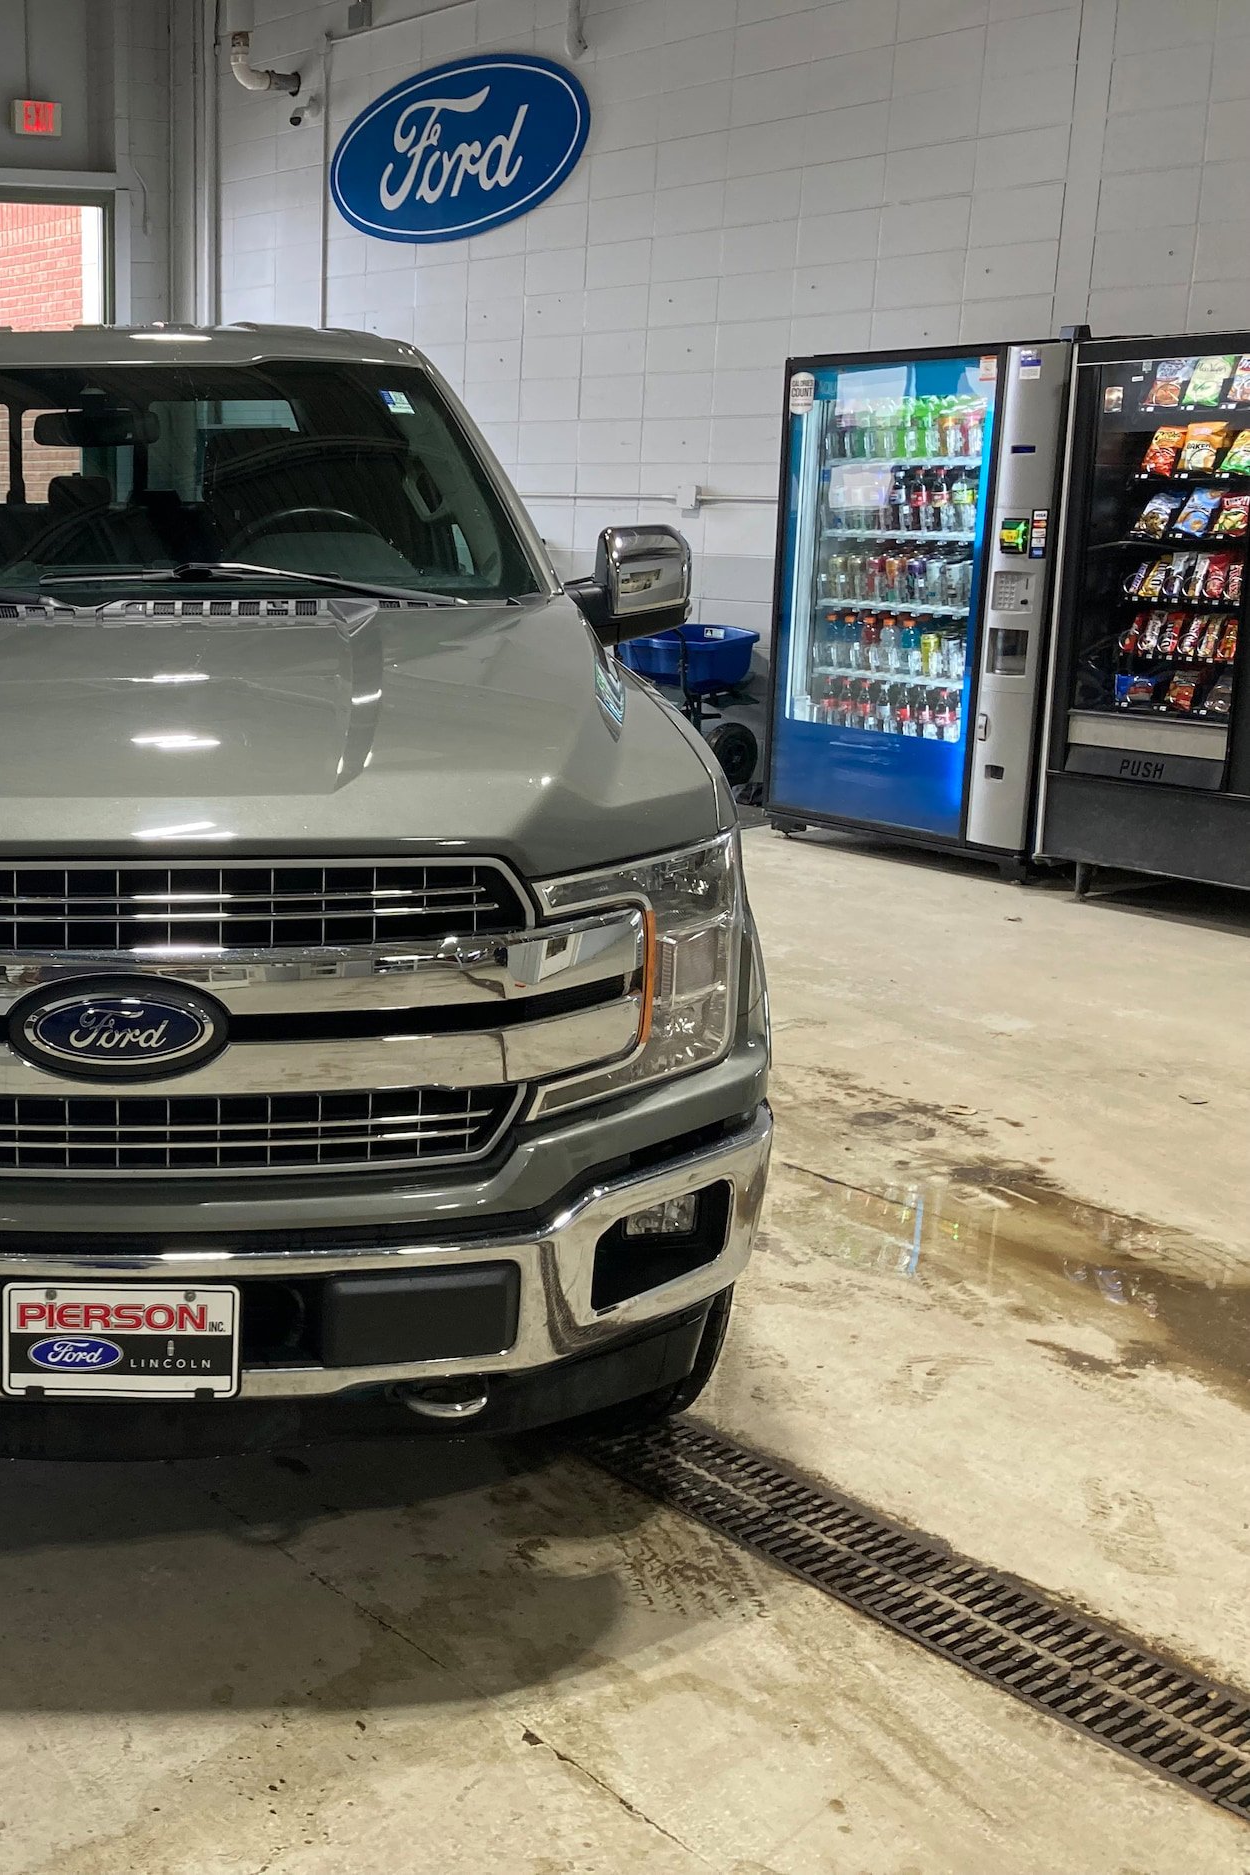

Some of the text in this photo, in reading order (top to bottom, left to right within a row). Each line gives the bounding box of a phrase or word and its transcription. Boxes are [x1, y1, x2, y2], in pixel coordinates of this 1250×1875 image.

[23, 101, 54, 132] EXIT
[379, 85, 529, 211] Ford
[791, 387, 813, 398] COUNT
[1119, 759, 1165, 780] PUSH
[69, 1007, 170, 1048] Ford
[17, 1302, 226, 1333] PIERSON INC.
[47, 1340, 103, 1364] Ford
[129, 1358, 211, 1369] LINCOLN
